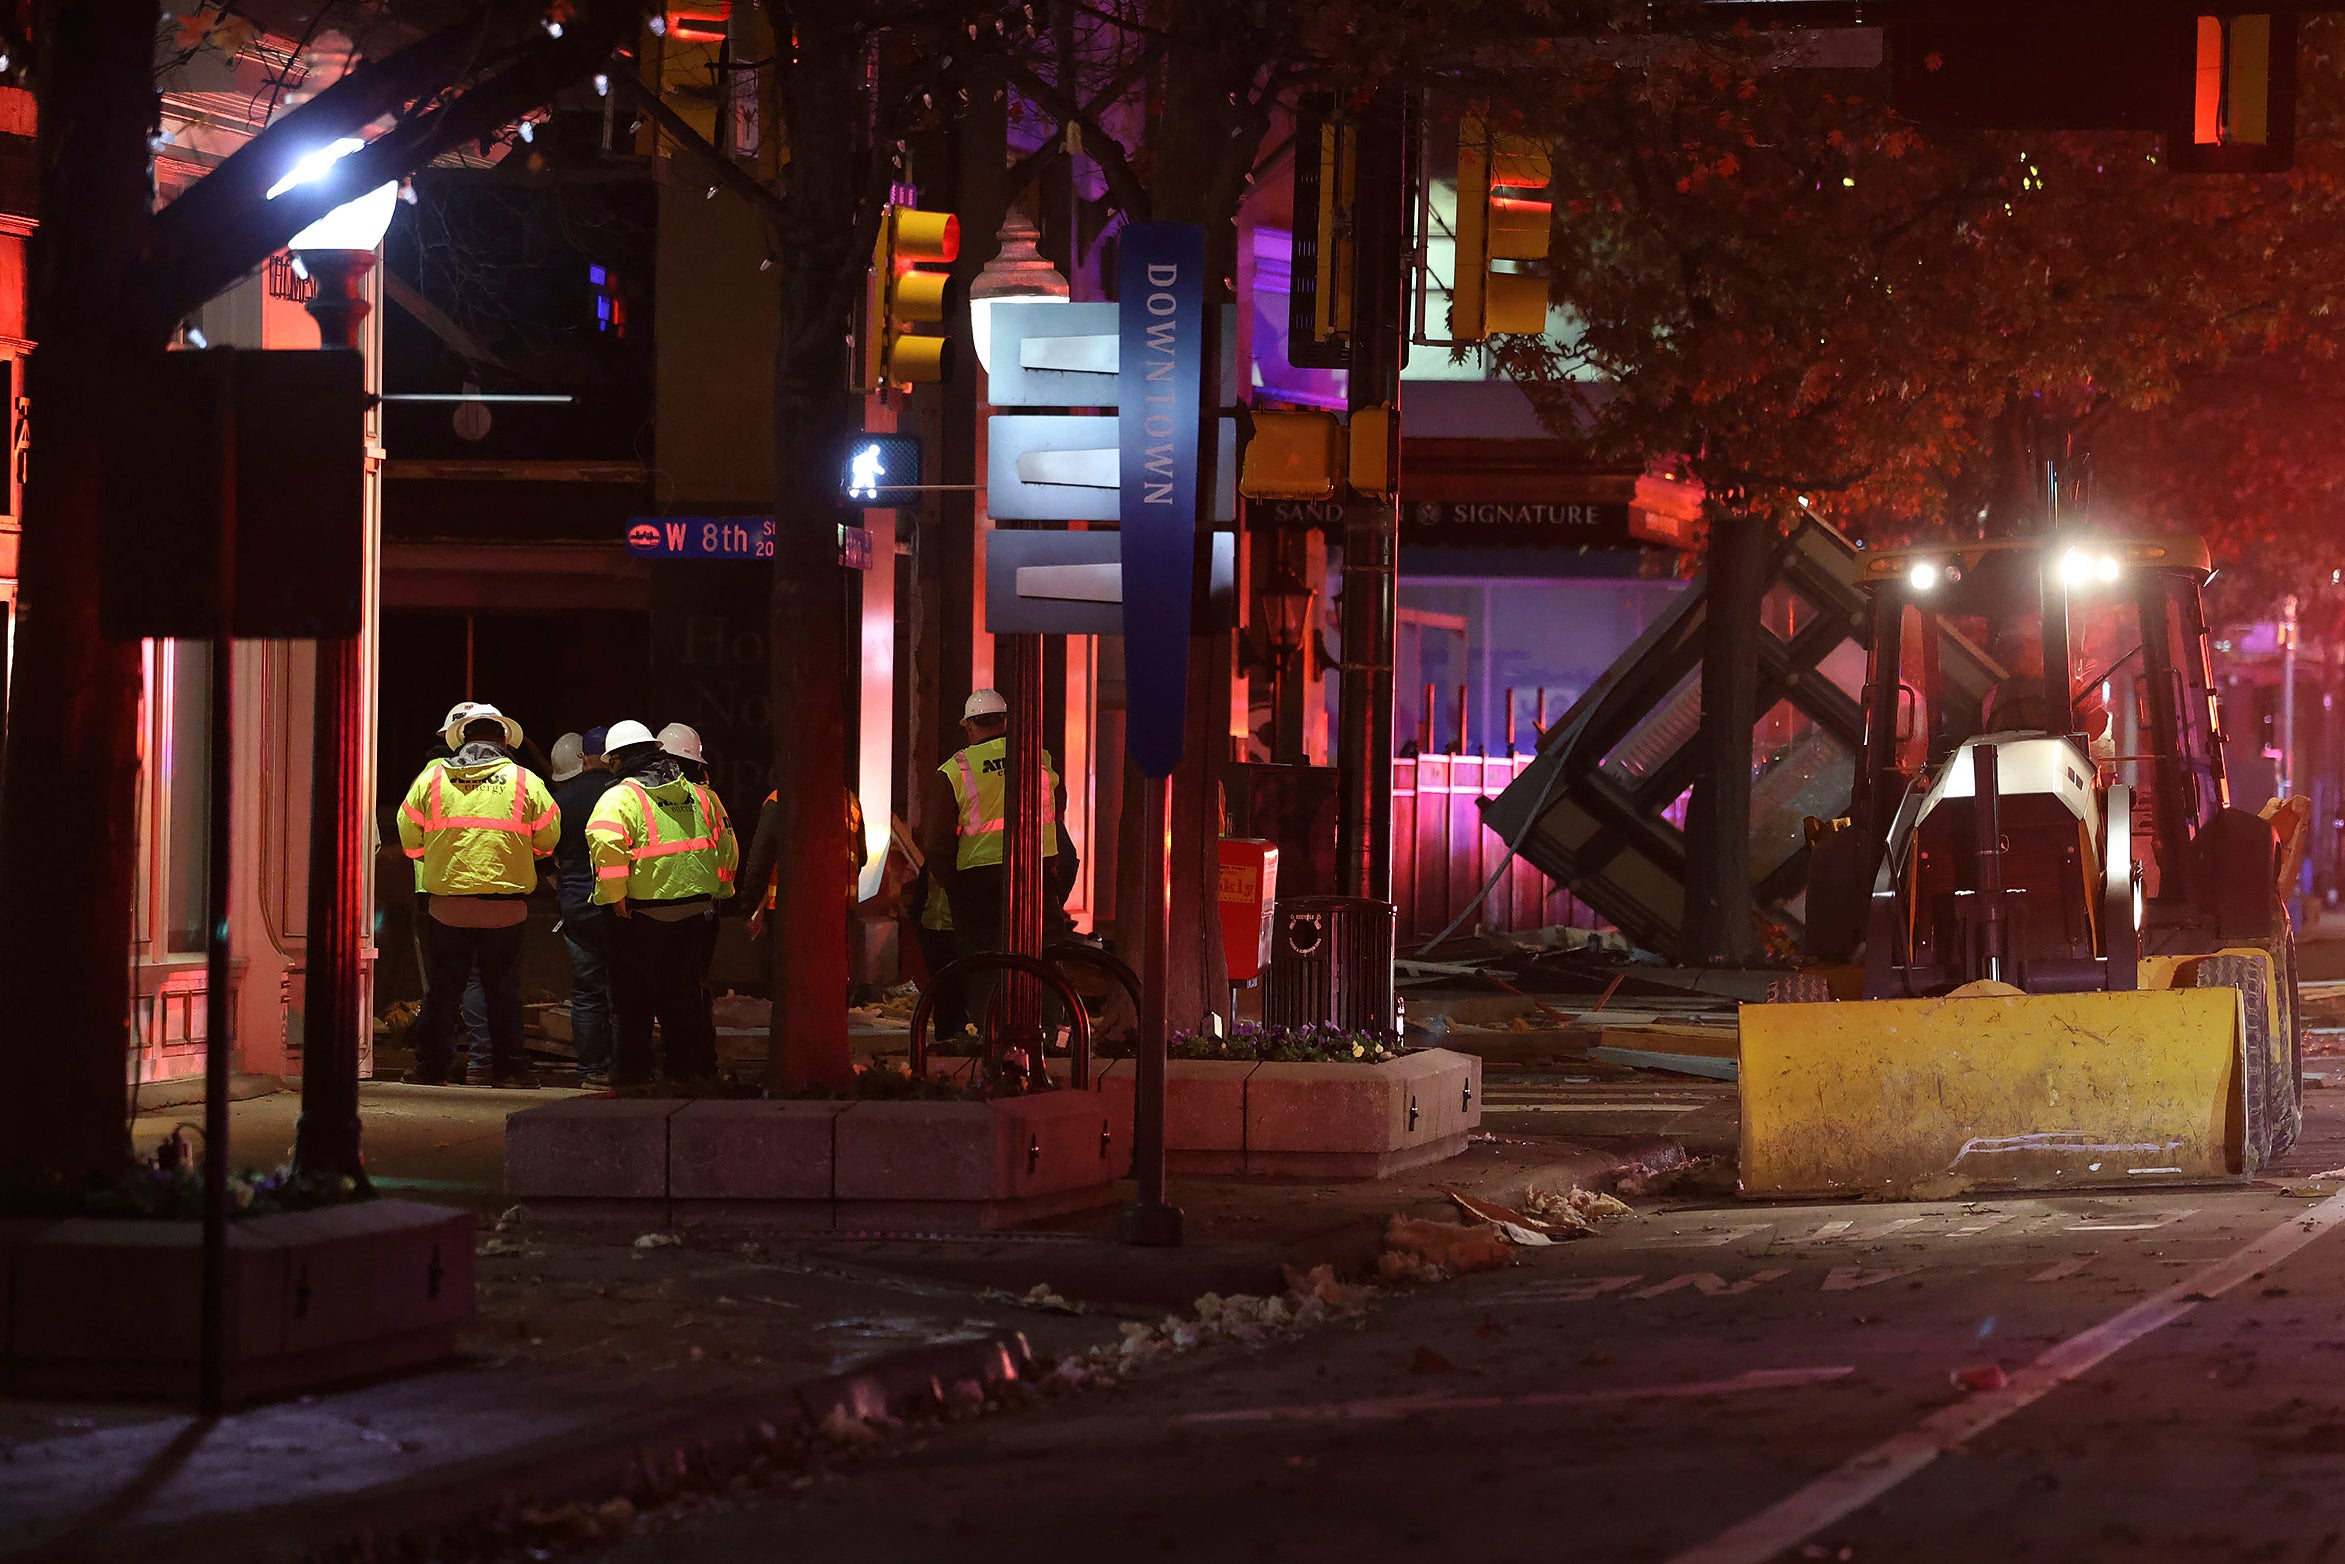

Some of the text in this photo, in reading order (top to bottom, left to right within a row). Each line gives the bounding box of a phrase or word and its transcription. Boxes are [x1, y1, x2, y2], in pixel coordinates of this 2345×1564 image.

[1144, 263, 1178, 505] DOWNTOWN
[1453, 504, 1599, 526] SIGNATURE
[665, 522, 749, 553] W 8th
[464, 784, 506, 795] energy
